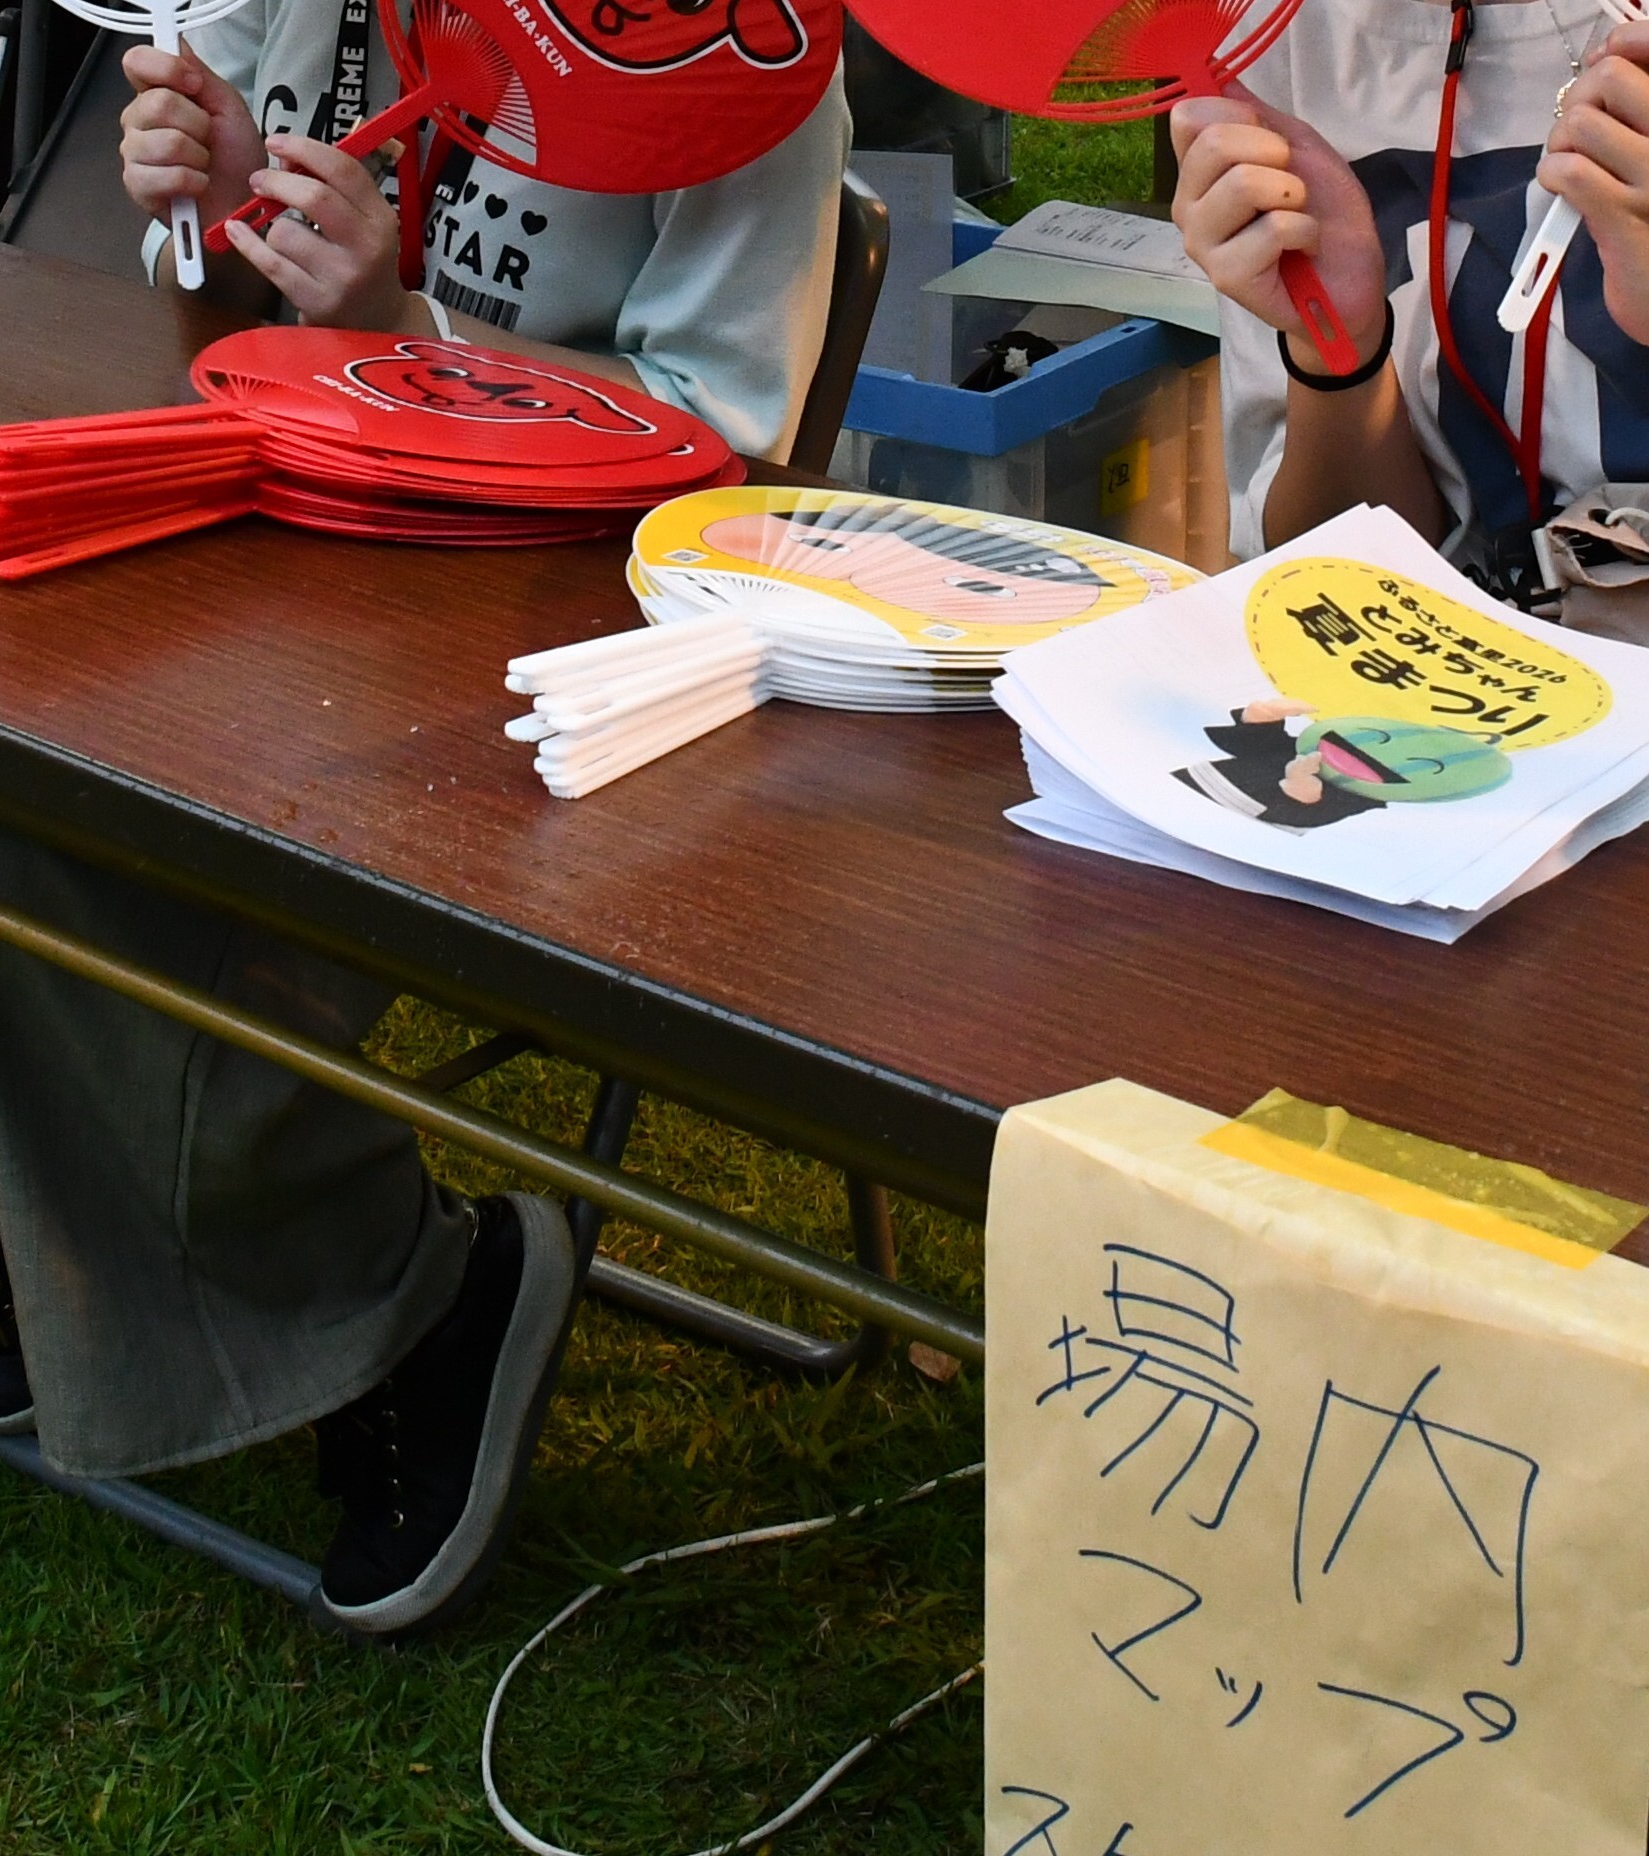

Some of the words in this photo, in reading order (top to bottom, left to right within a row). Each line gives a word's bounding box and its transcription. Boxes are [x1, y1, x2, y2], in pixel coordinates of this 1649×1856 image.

[1285, 591, 1550, 737] 夏まつり
[1360, 604, 1538, 703] とみちゃん
[1036, 1243, 1540, 1668] 場内
[1078, 1548, 1517, 1819] マップ
